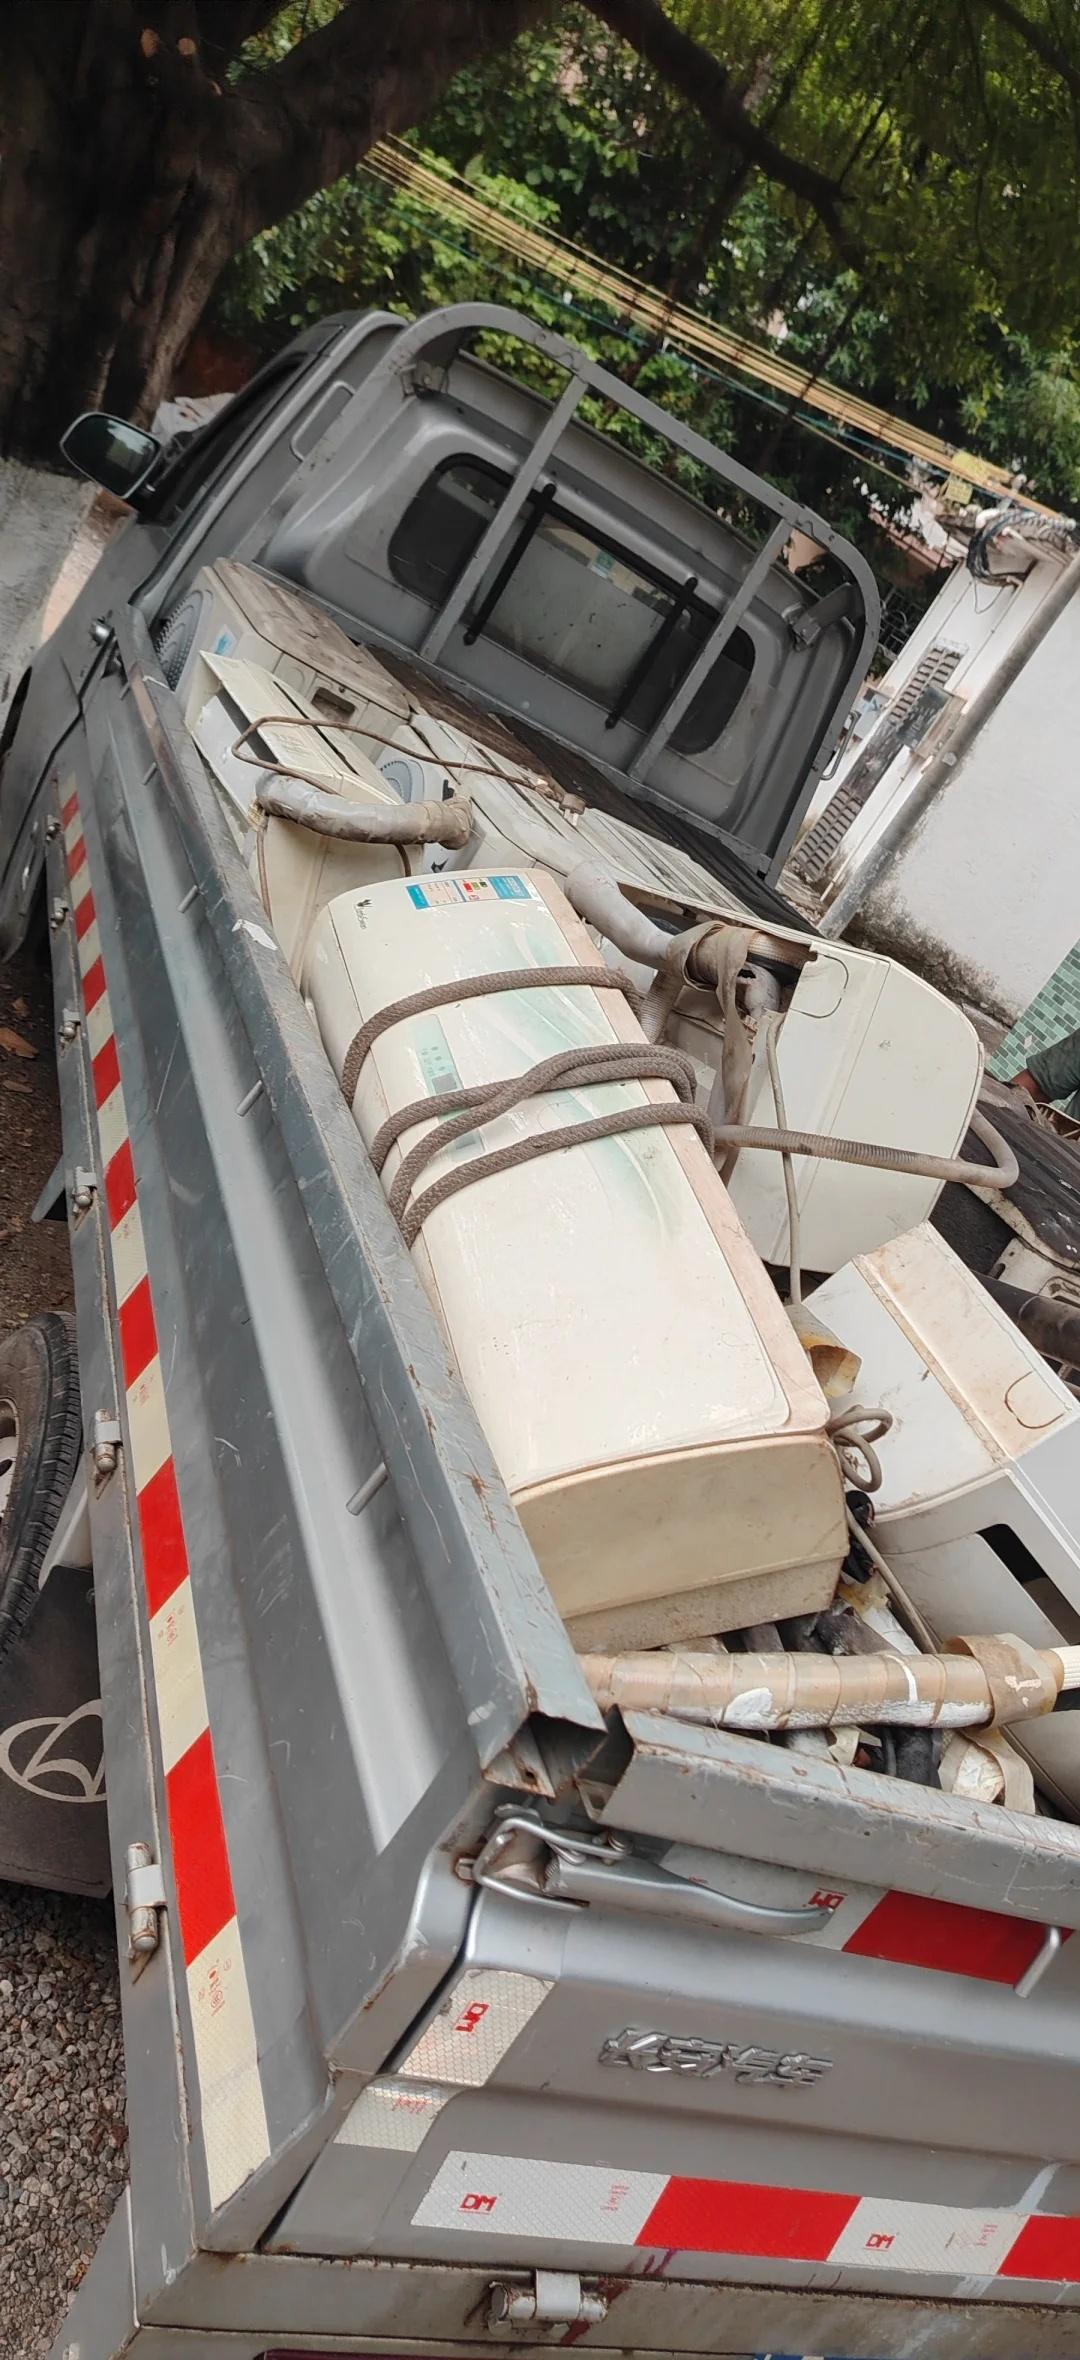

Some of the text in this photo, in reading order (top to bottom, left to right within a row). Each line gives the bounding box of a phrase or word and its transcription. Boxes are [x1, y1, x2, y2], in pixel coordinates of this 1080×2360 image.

[808, 1889, 845, 1910] DM
[455, 2002, 490, 2033] DM
[599, 2027, 833, 2088] 长安汽车
[460, 2193, 497, 2212] DM
[865, 2233, 896, 2249] DM
